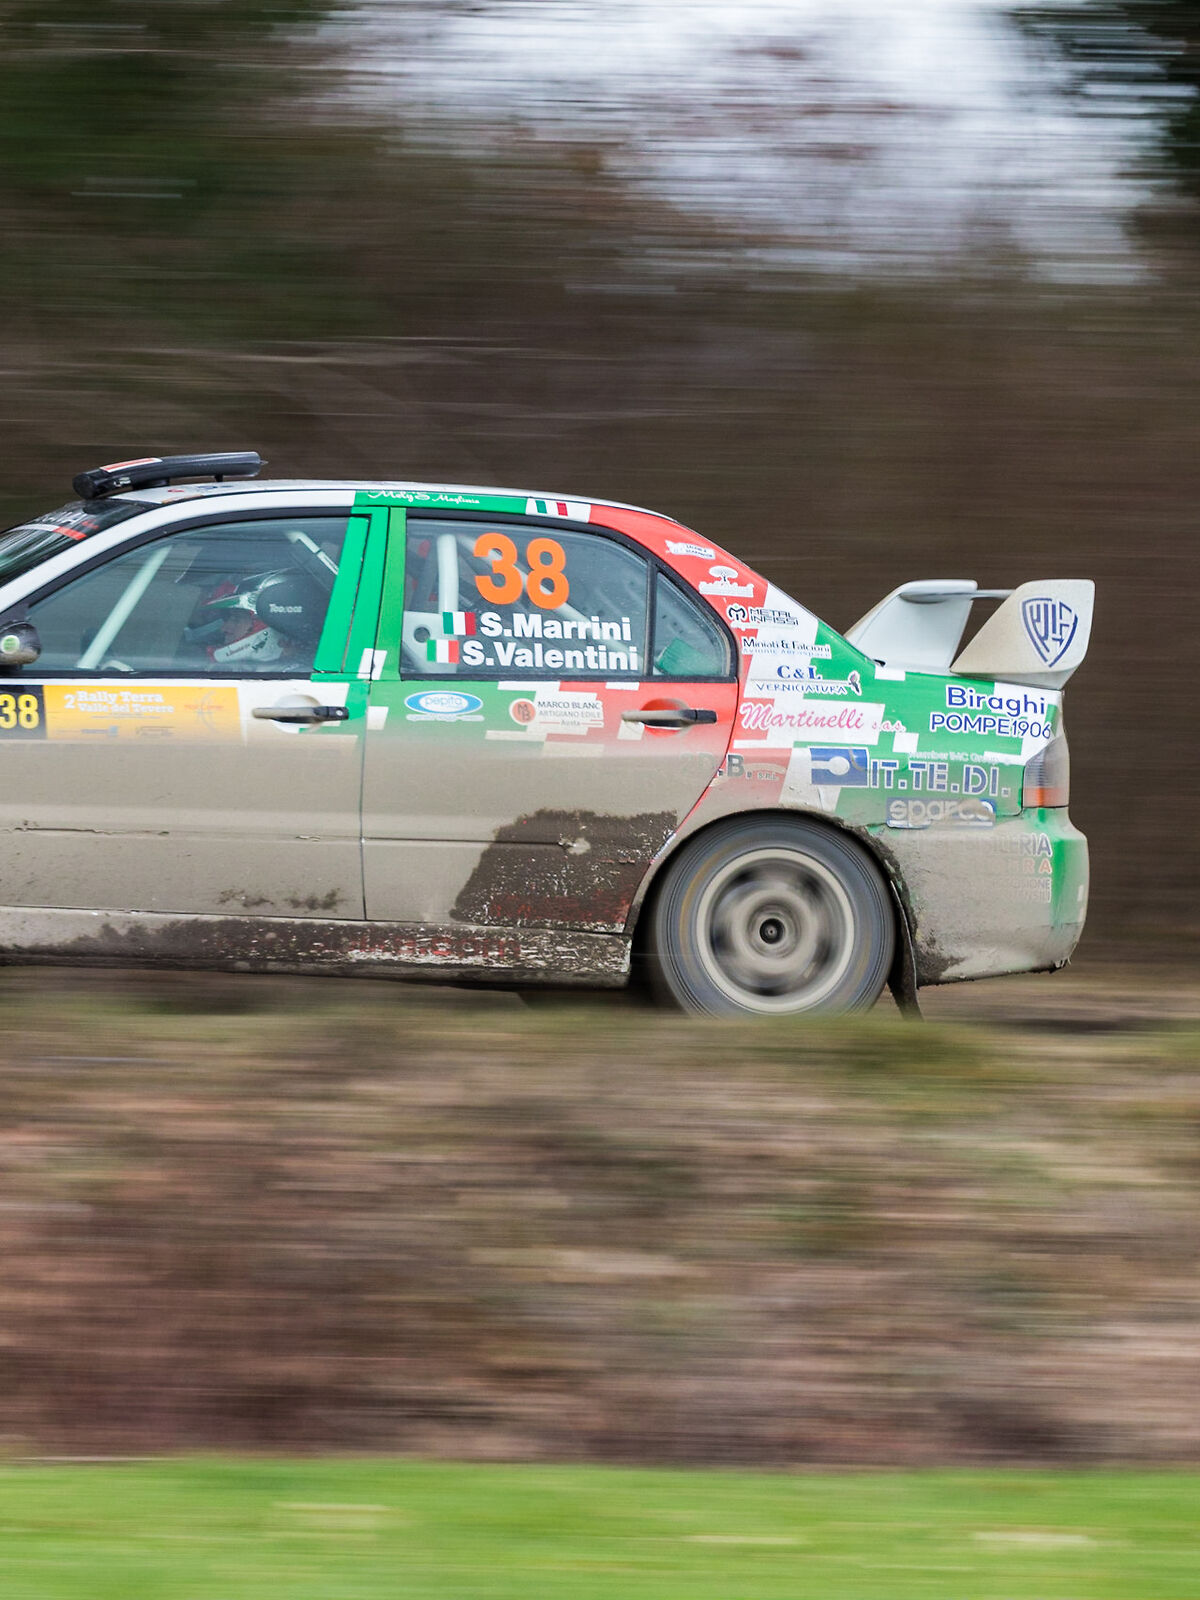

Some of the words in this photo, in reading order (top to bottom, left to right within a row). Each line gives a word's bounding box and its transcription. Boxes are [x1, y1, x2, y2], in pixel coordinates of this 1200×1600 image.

[473, 532, 570, 610] 38
[480, 611, 632, 642] S.Marrini
[462, 642, 638, 671] S.Valentini
[777, 665, 791, 679] C
[793, 667, 804, 679] &
[808, 666, 822, 680] L
[77, 691, 116, 705] Rally
[120, 691, 164, 703] Terra
[78, 703, 108, 713] Valle
[112, 703, 129, 713] del
[537, 701, 570, 709] MARCO
[947, 686, 1046, 717] Biraghi
[742, 704, 864, 729] Martinelli
[889, 799, 994, 826] sparco
